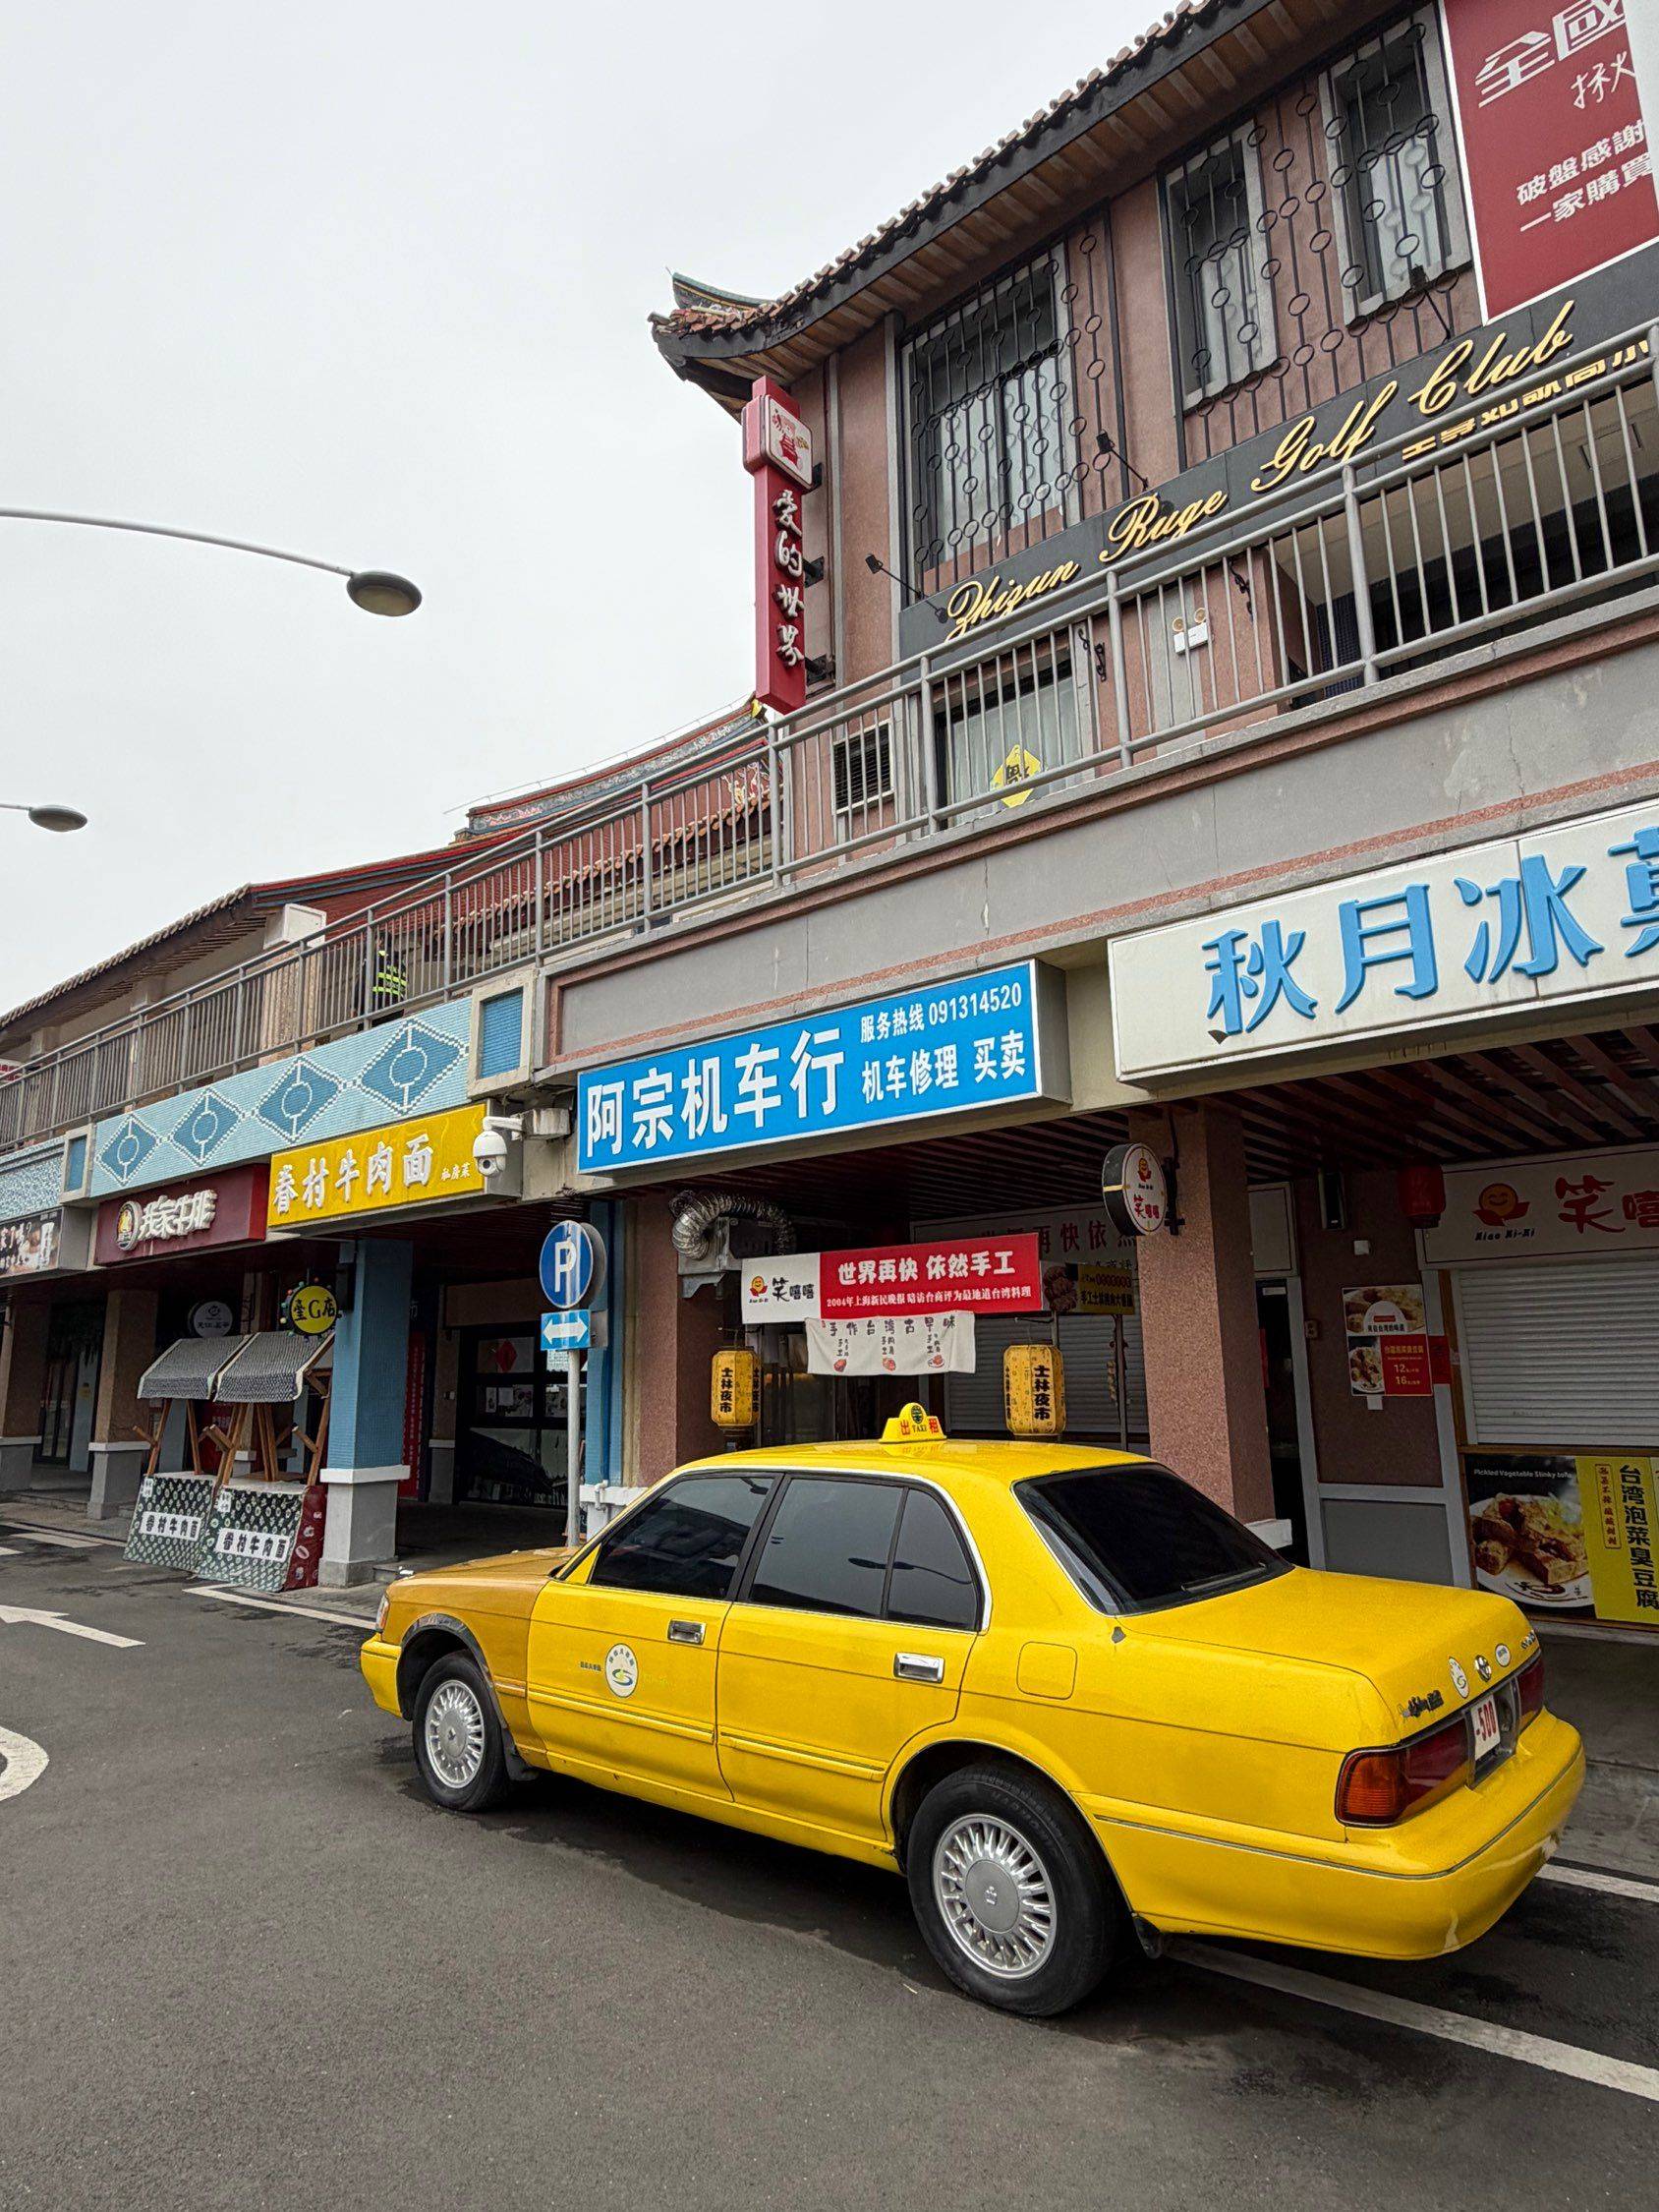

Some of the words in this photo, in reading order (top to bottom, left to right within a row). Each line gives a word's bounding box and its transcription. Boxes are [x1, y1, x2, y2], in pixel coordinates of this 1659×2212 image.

[1516, 119, 1648, 205] 破盤感謝
[1520, 153, 1653, 232] 一家購買
[944, 559, 1079, 644] Zhizun
[1098, 490, 1228, 562] Ruge
[1252, 380, 1398, 492] Golf
[1407, 300, 1573, 415] Club
[861, 1003, 925, 1043] 服务热线
[929, 981, 1023, 1025] 091314520
[587, 1027, 845, 1158] 阿宗机车行
[861, 1043, 959, 1104] 机车修理
[973, 1028, 1026, 1083] 买卖
[273, 1134, 434, 1215] 眷村牛肉面
[554, 1239, 577, 1293] P
[772, 1277, 815, 1303] 笑嘻嘻
[837, 1255, 919, 1287] 世界再快
[925, 1250, 1016, 1280] 依然手工
[719, 1367, 733, 1414] 士林夜市
[1034, 1365, 1051, 1421] 士林夜市
[1619, 1464, 1659, 1609] 台湾泡菜臭豆腐
